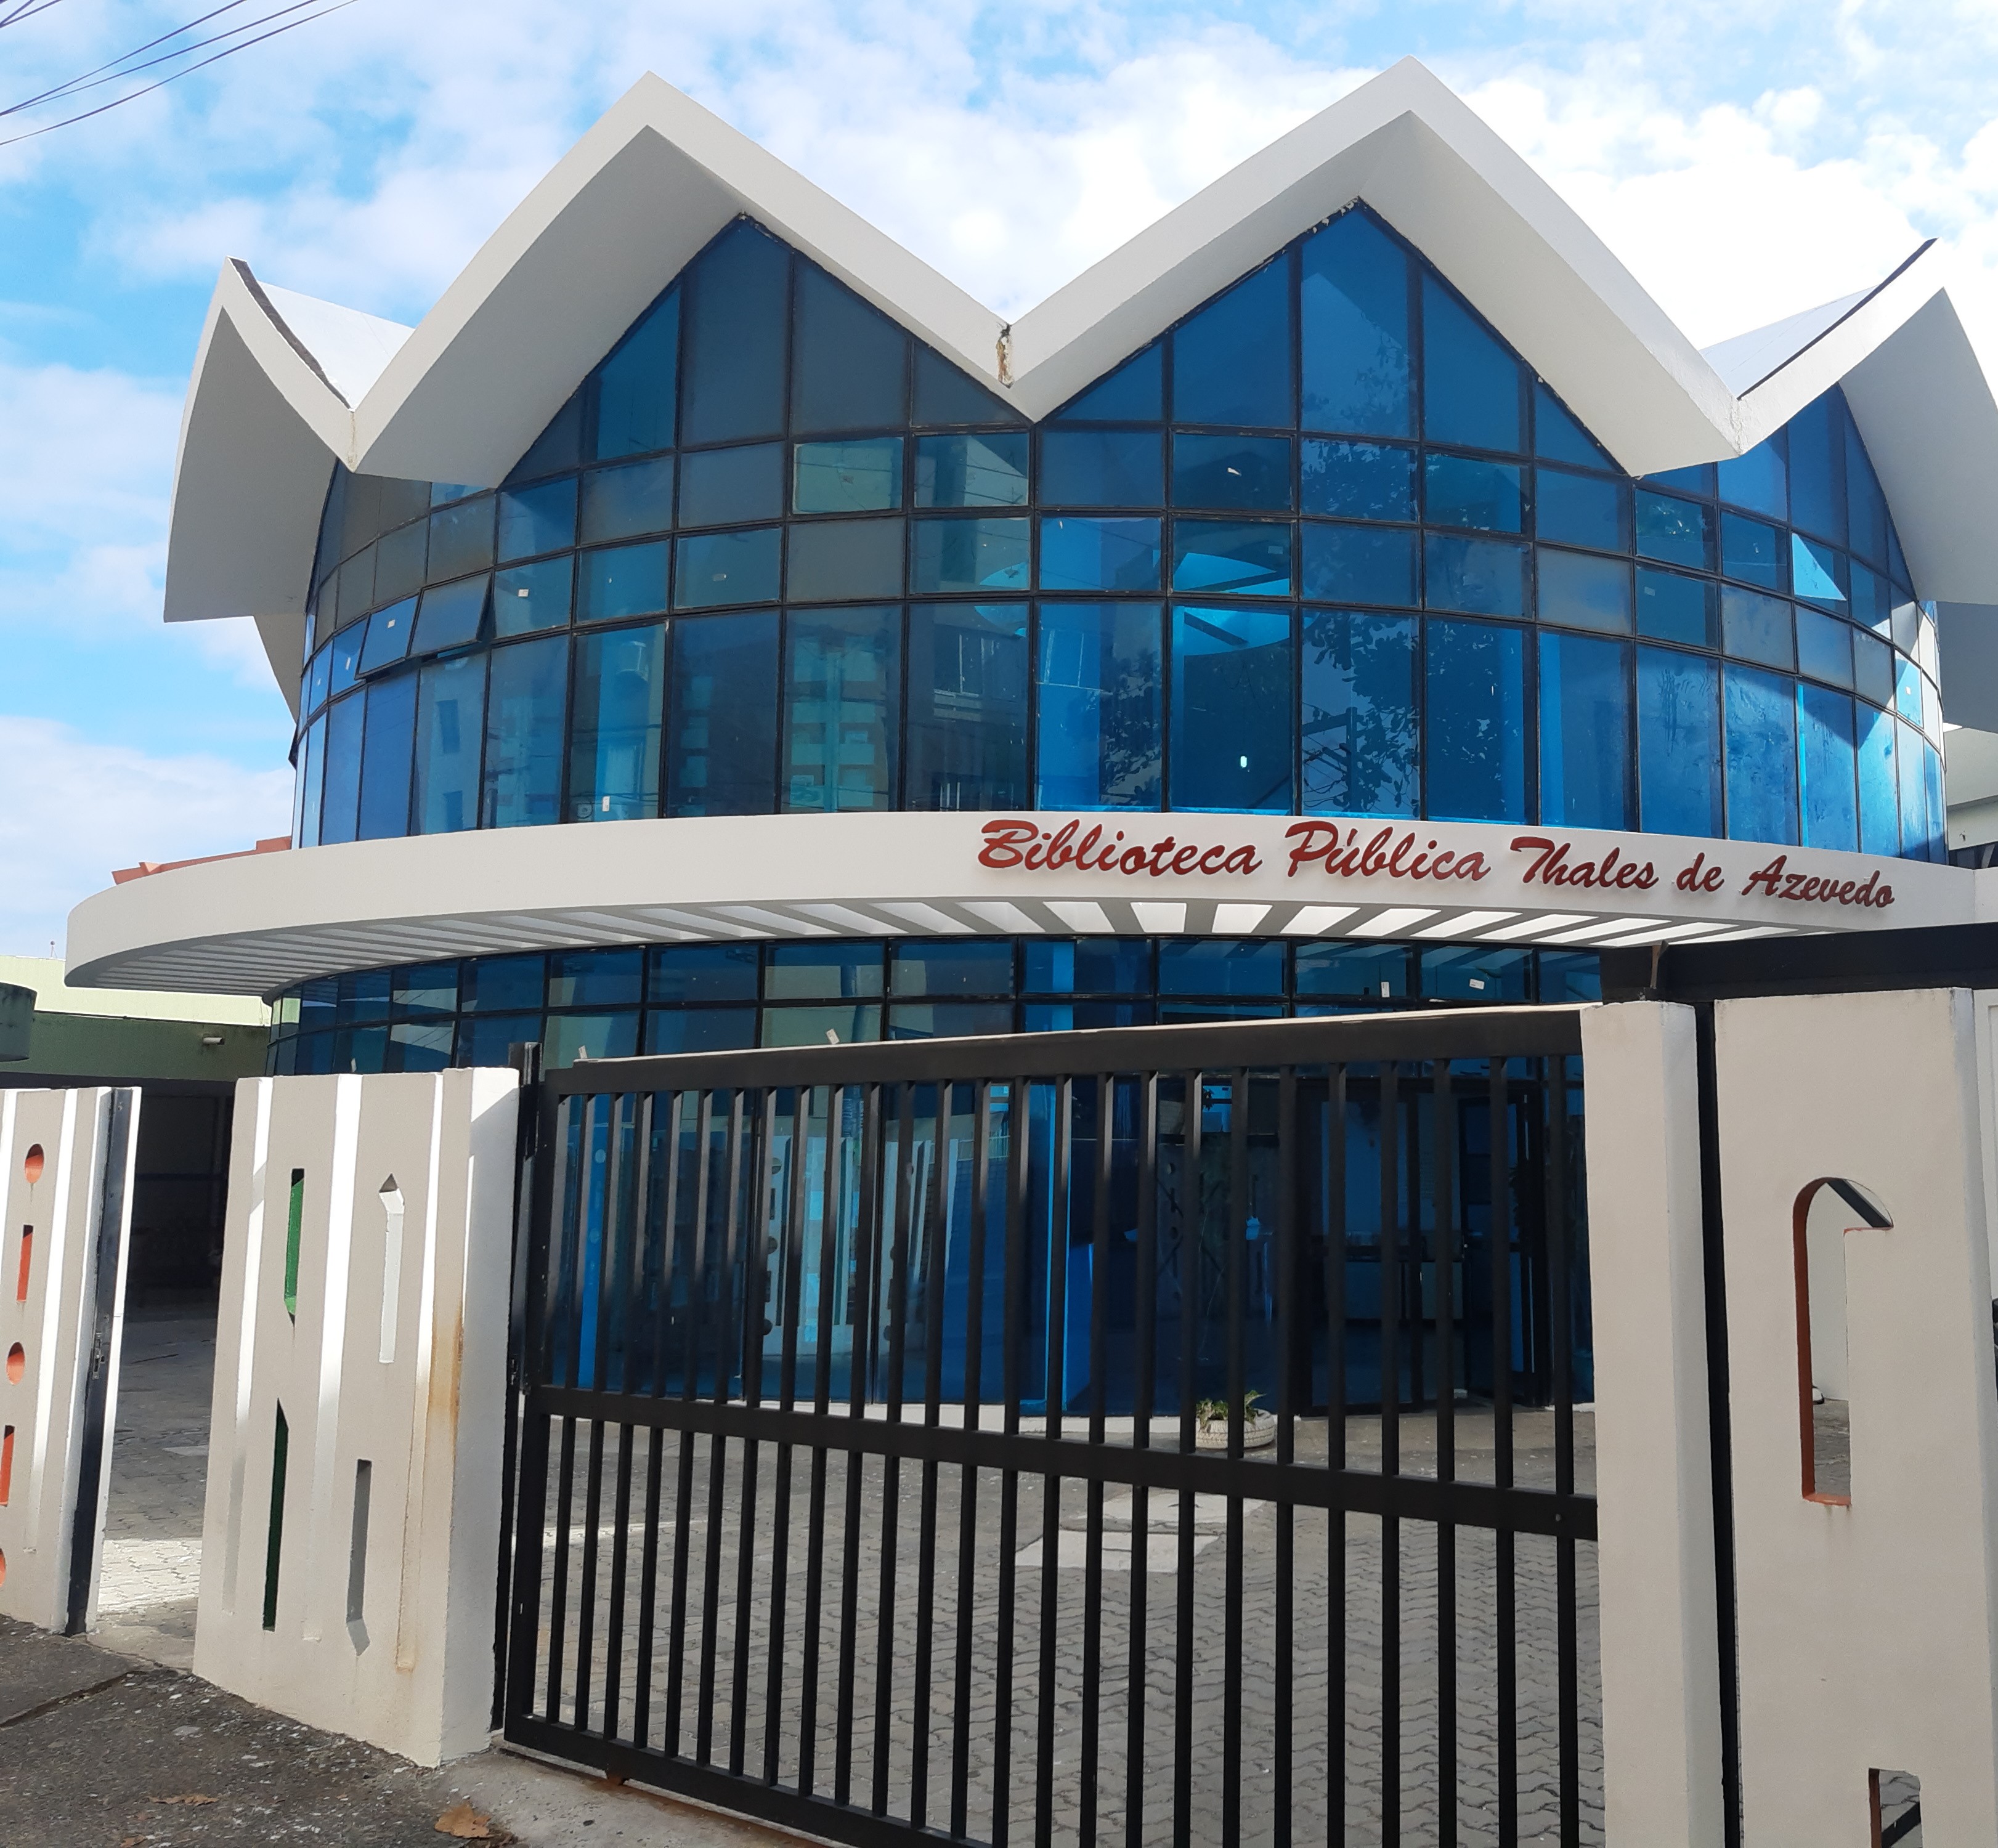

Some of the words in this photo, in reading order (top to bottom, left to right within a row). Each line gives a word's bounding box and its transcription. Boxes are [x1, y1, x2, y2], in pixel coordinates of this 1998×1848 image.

[978, 819, 1262, 877] Biblioteca
[1285, 821, 1491, 881] Pública
[1510, 836, 1659, 890] Thales
[1676, 852, 1724, 893] de
[1741, 854, 1896, 909] Azevedo
